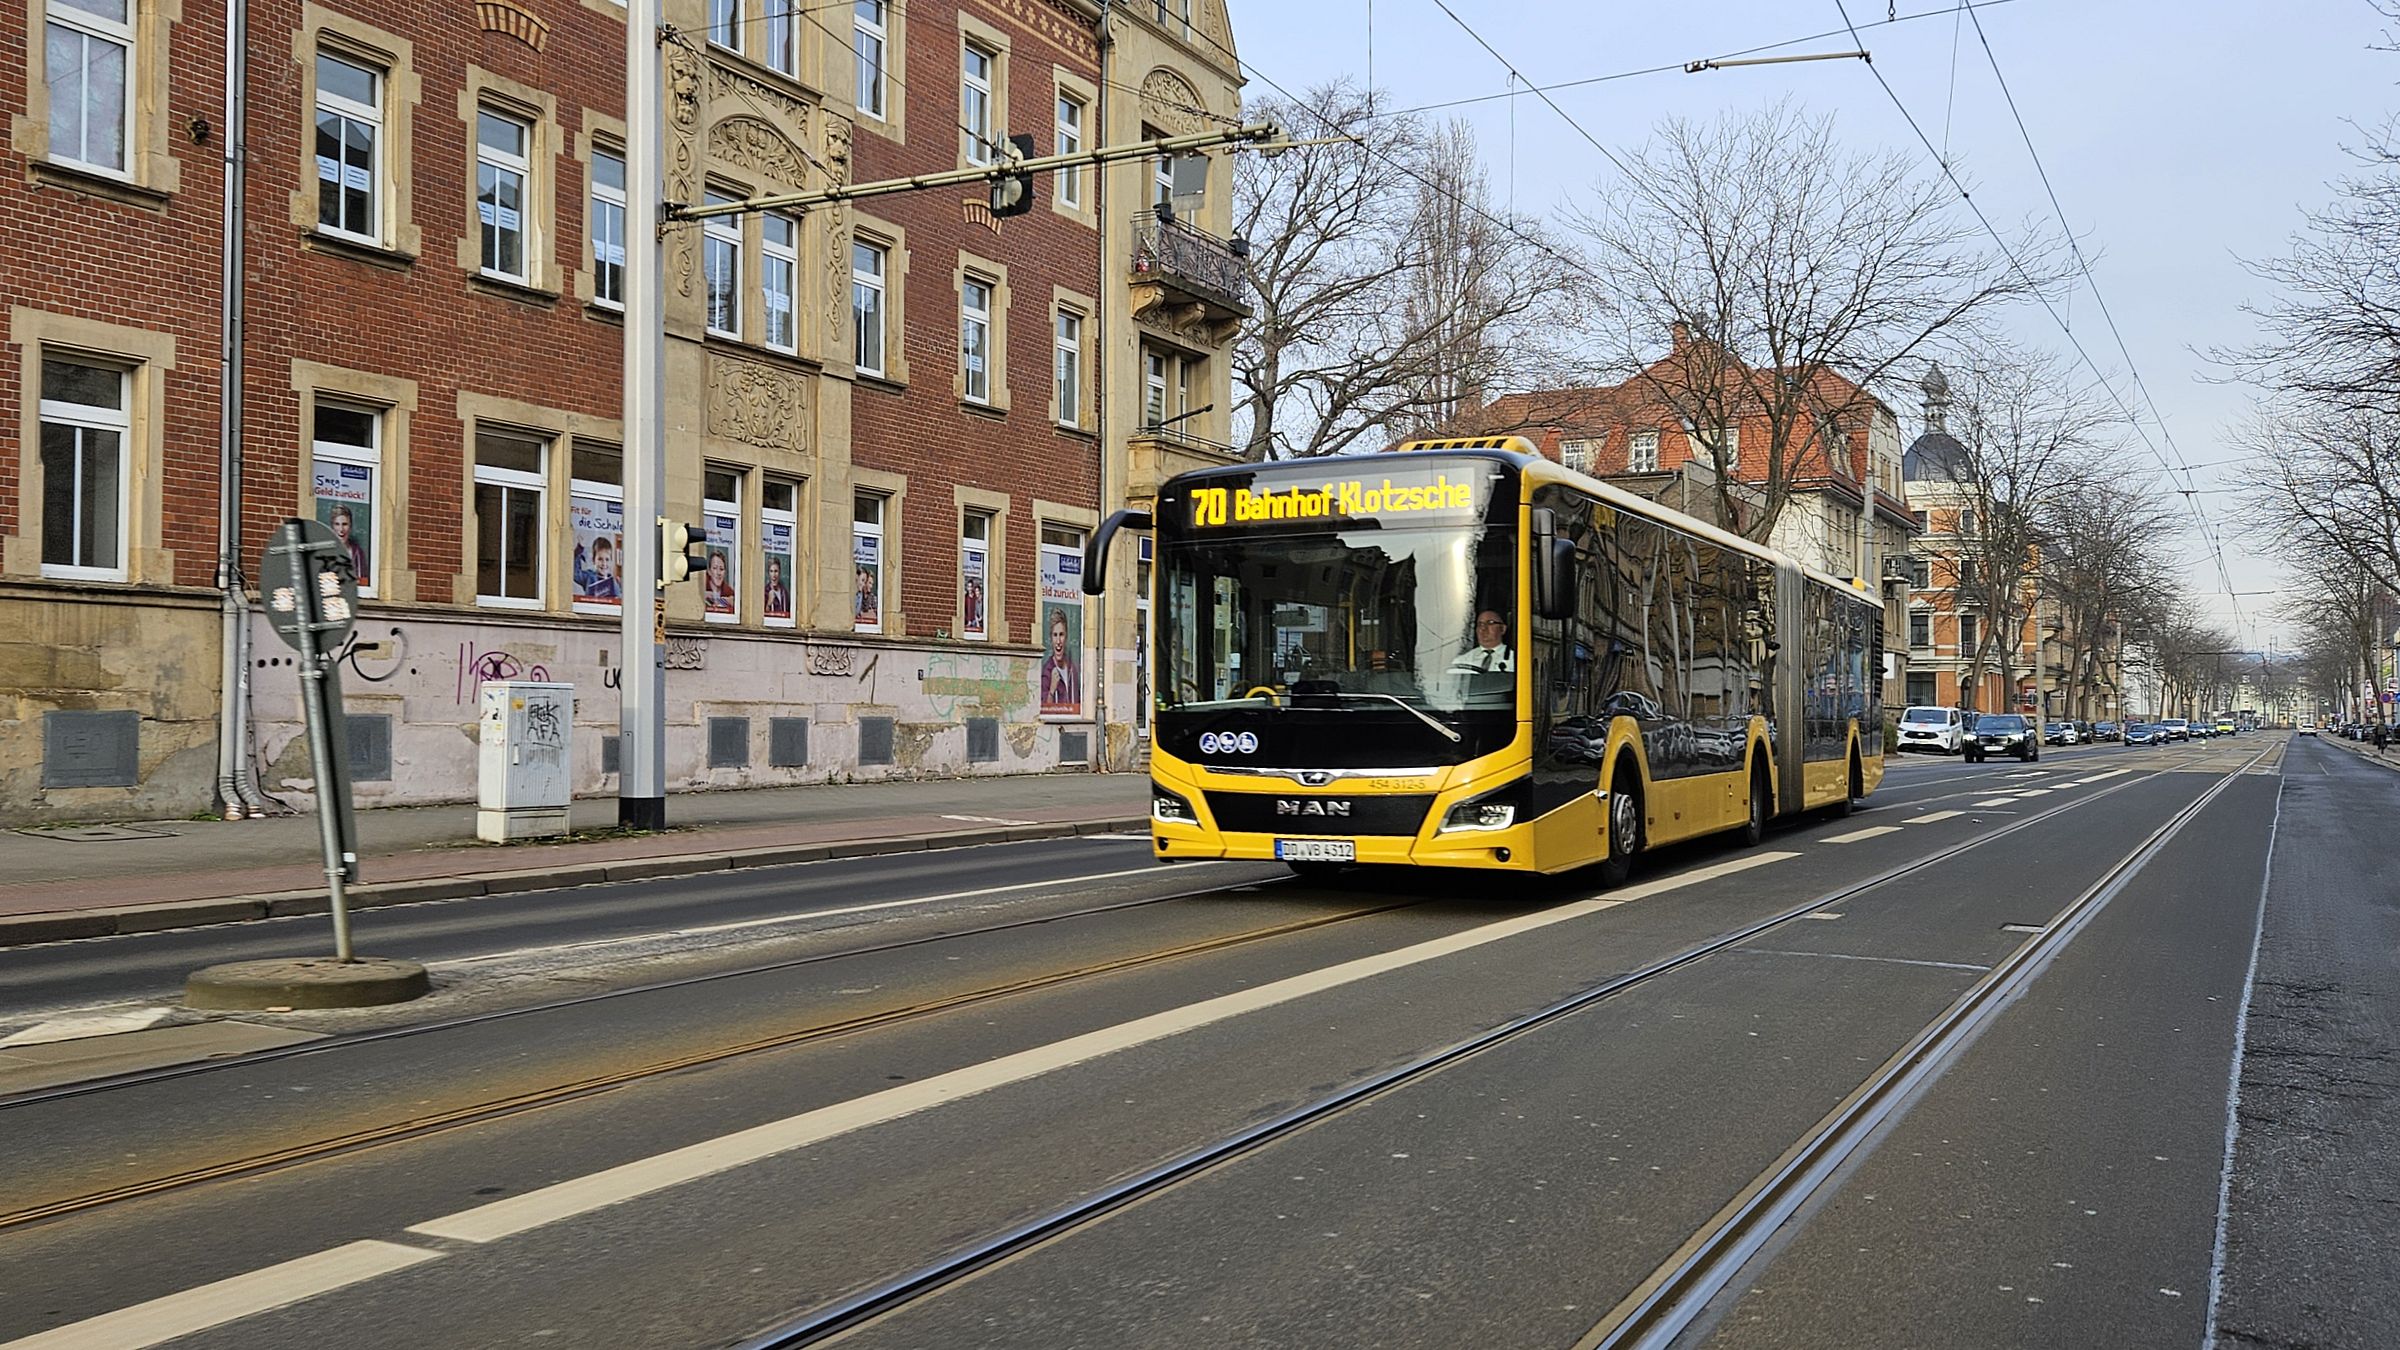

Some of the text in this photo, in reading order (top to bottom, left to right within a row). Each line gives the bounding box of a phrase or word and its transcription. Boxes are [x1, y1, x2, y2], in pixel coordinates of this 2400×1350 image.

[314, 487, 365, 500] Geld zurück!
[1191, 475, 1471, 526] 70 Bahnhof Klotzsche
[579, 517, 592, 529] die
[1041, 586, 1079, 600] eld zurück!
[1369, 779, 1426, 790] 454 312-5
[1277, 800, 1351, 816] MAN
[1284, 843, 1352, 857] DD VB 4312
